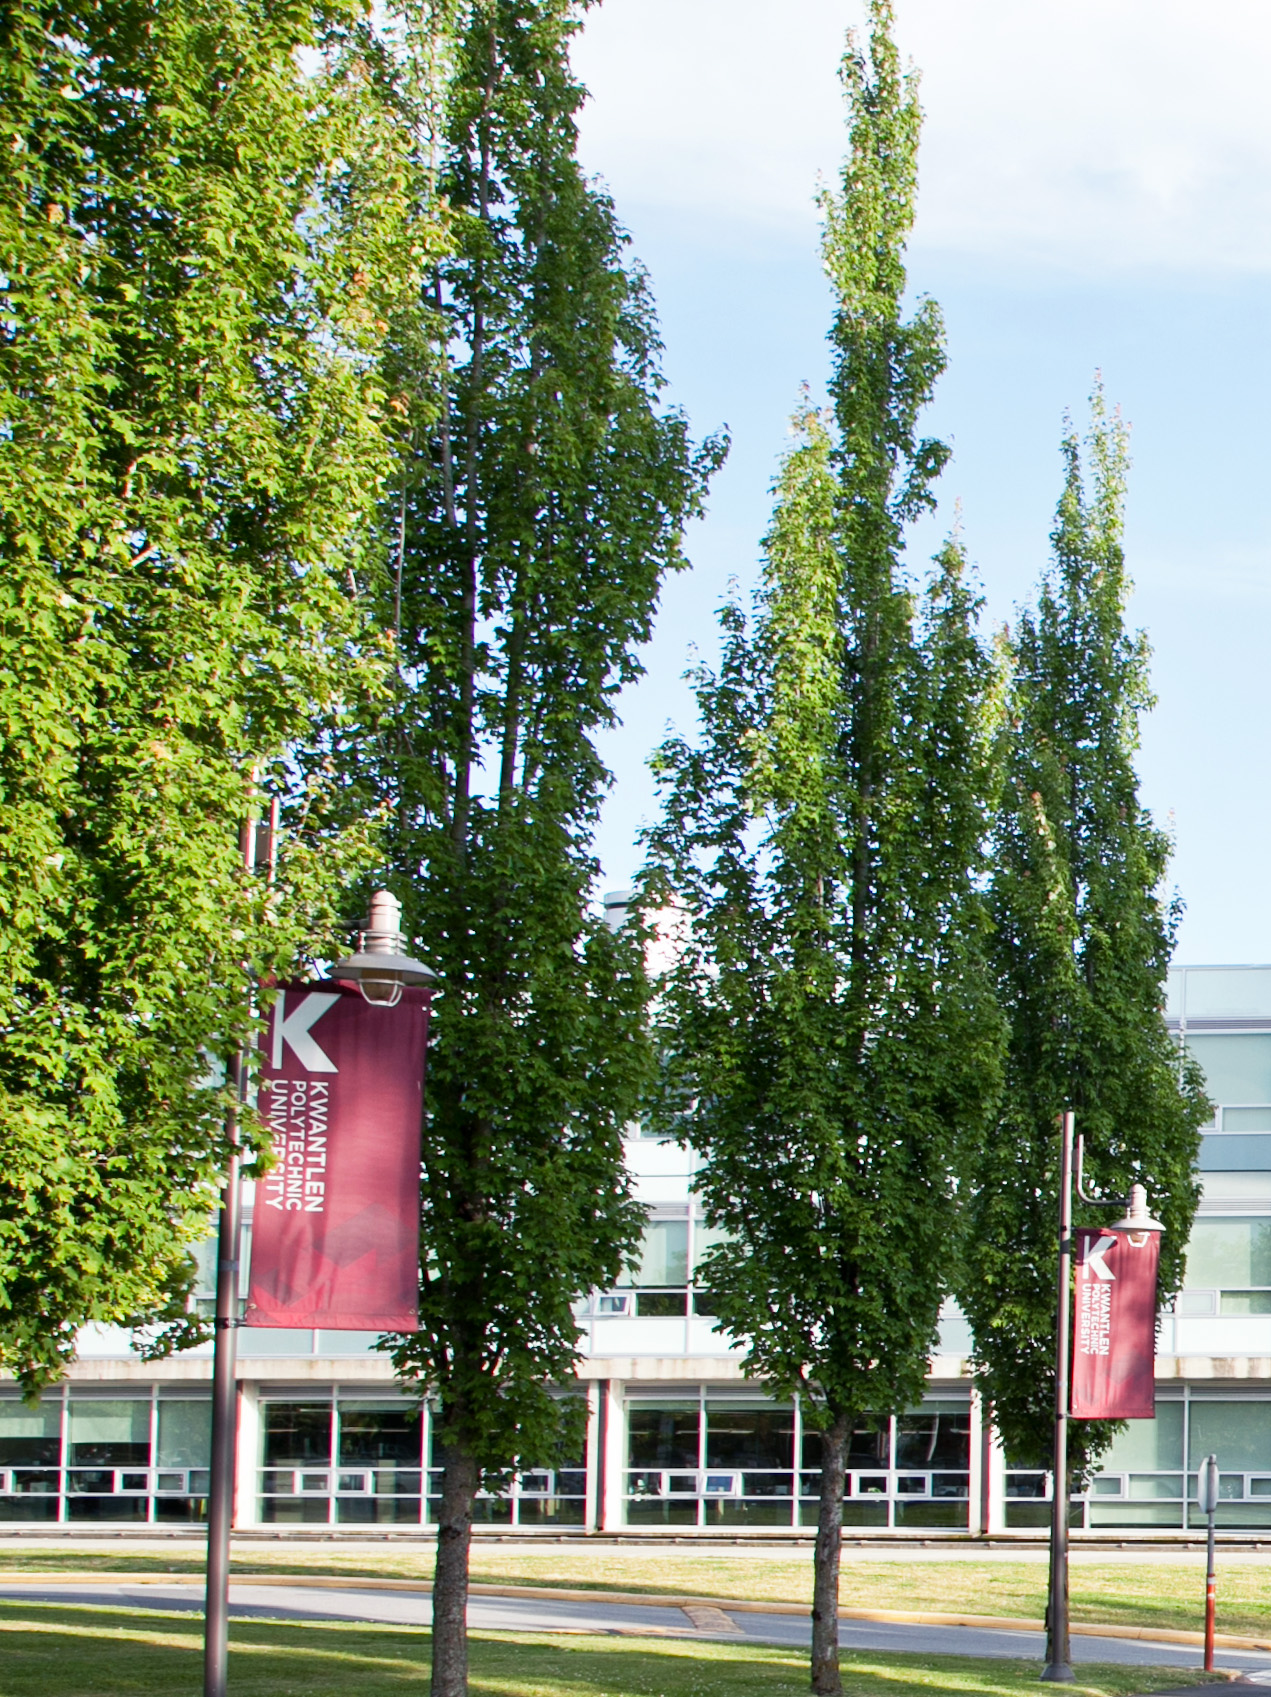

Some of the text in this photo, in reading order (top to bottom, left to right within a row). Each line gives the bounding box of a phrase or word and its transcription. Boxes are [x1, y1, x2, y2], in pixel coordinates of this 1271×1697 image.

[271, 989, 342, 1073] K
[285, 1080, 307, 1211] POLYTECHNIC
[304, 1081, 329, 1212] KWANTLEN
[1082, 1235, 1117, 1280] K
[1080, 1283, 1091, 1355] UNIVERSITY
[1090, 1283, 1100, 1355] POLYTECHNIC
[1099, 1283, 1111, 1355] KWANTLEN
